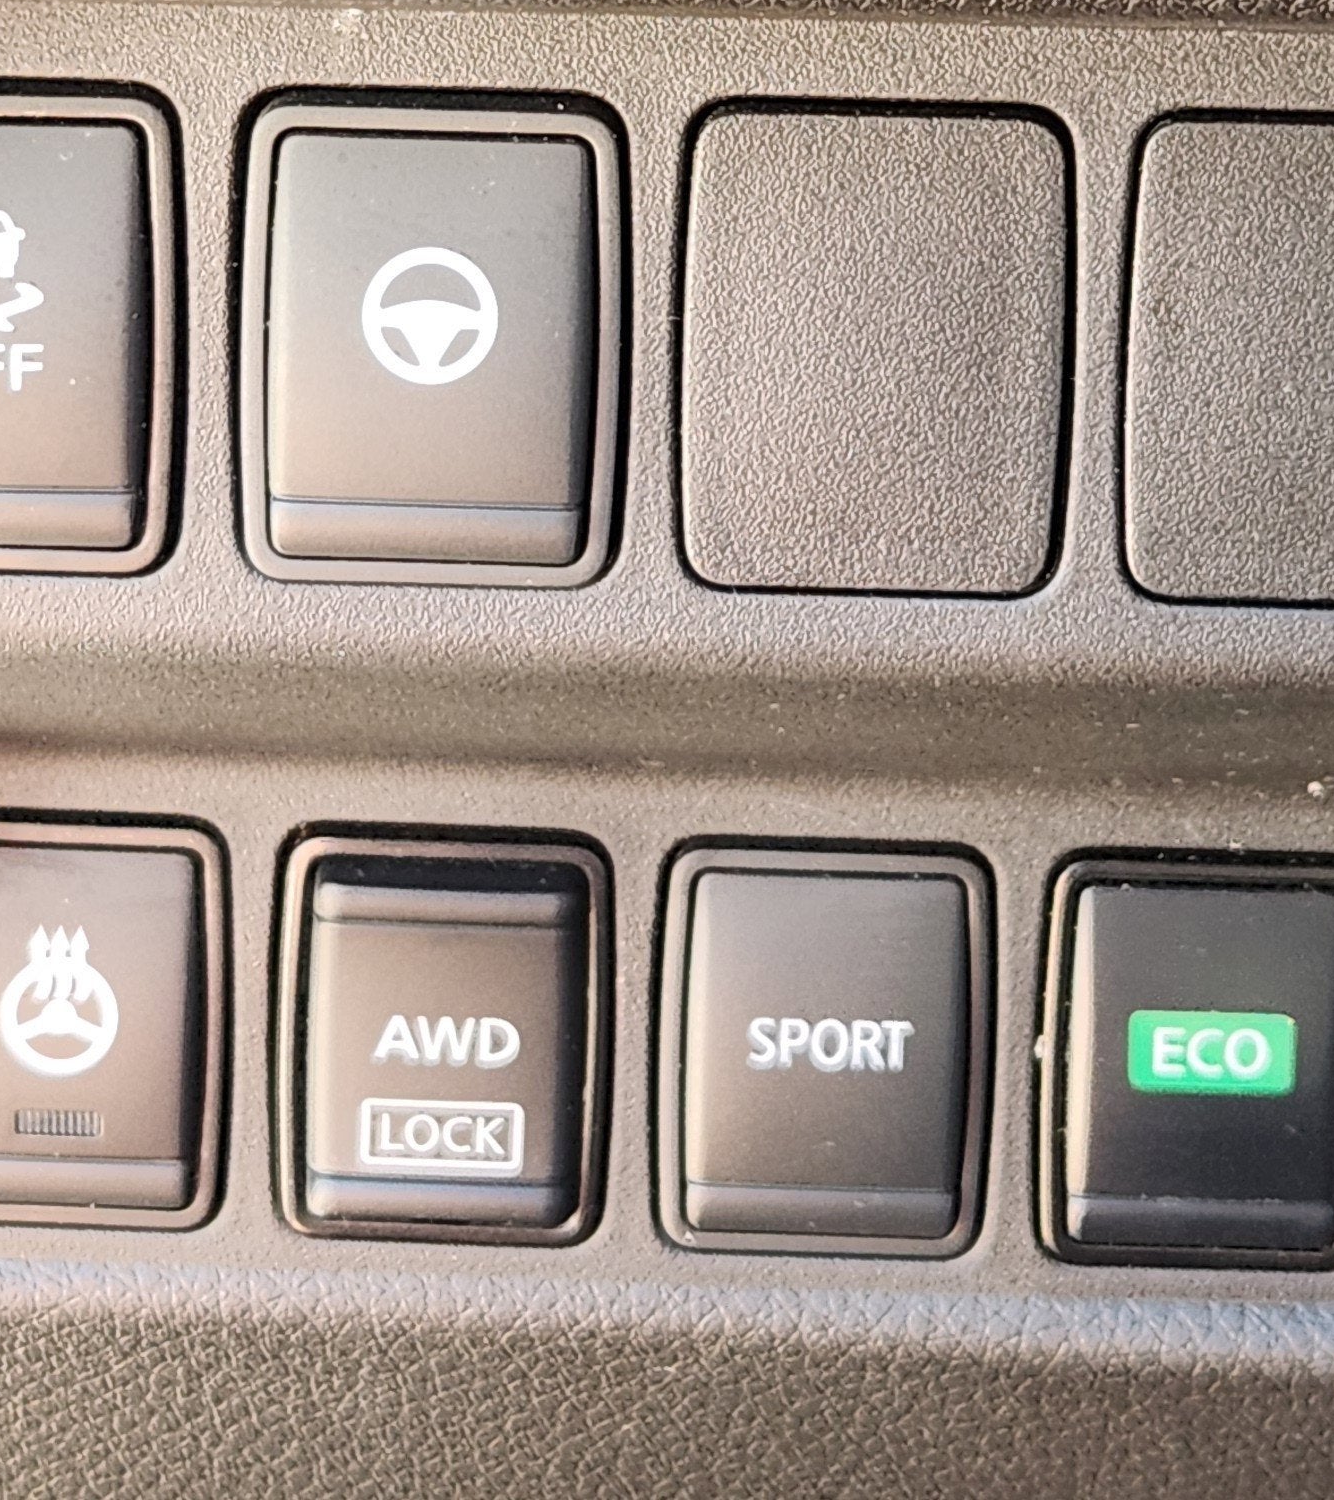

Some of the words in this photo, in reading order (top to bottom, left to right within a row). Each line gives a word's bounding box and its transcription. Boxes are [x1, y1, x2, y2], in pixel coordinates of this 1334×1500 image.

[371, 1015, 520, 1069] AWD
[746, 1017, 916, 1072] SPORT
[1152, 1027, 1272, 1080] ECO
[380, 1112, 505, 1154] LOCK
